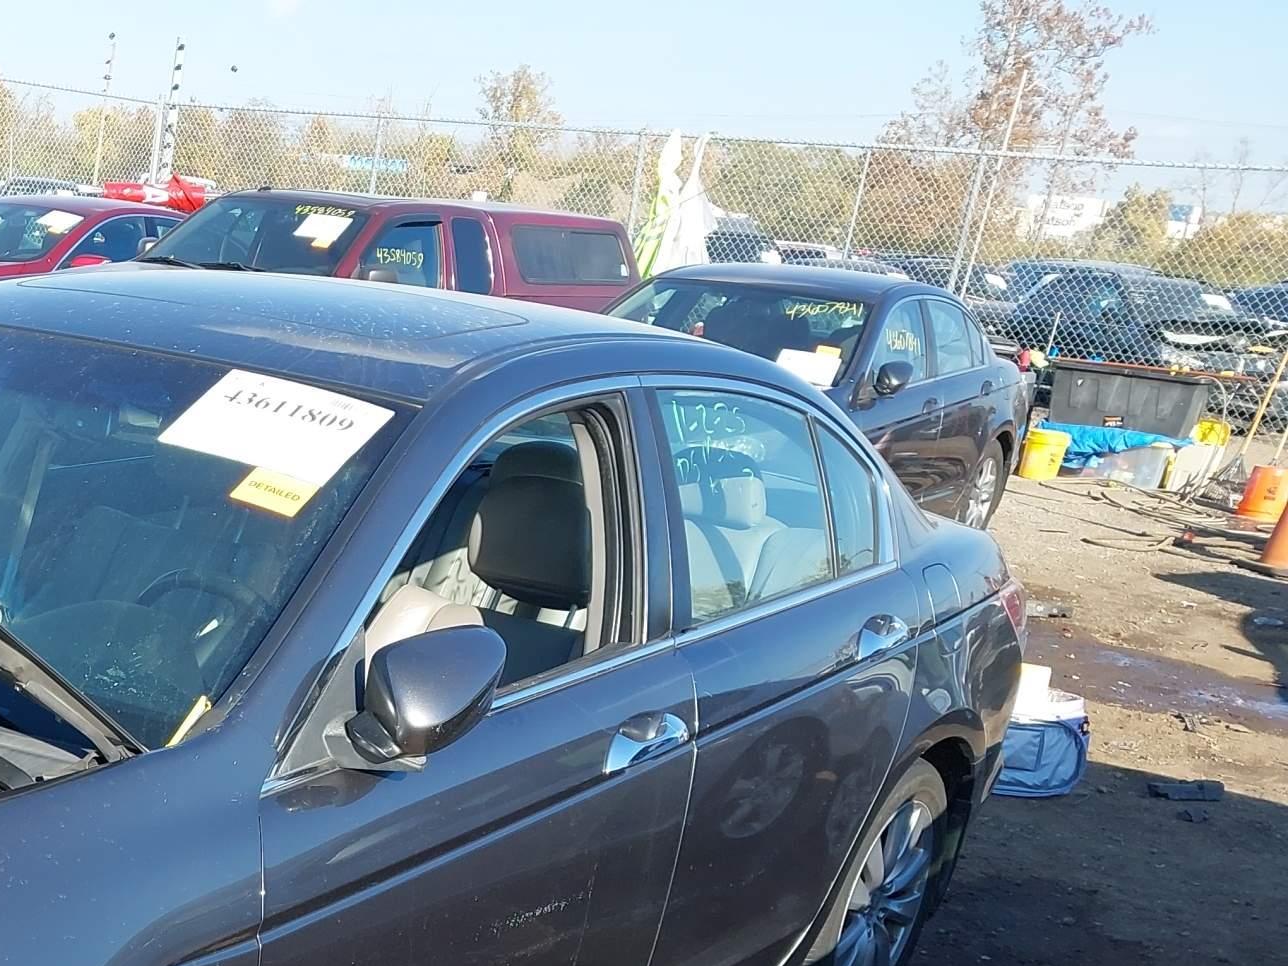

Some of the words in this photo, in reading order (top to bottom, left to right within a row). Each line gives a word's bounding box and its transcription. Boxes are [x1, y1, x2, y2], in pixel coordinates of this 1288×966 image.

[376, 247, 424, 269] 43584059
[223, 390, 355, 431] 43611809
[248, 479, 301, 502] DETAILED
